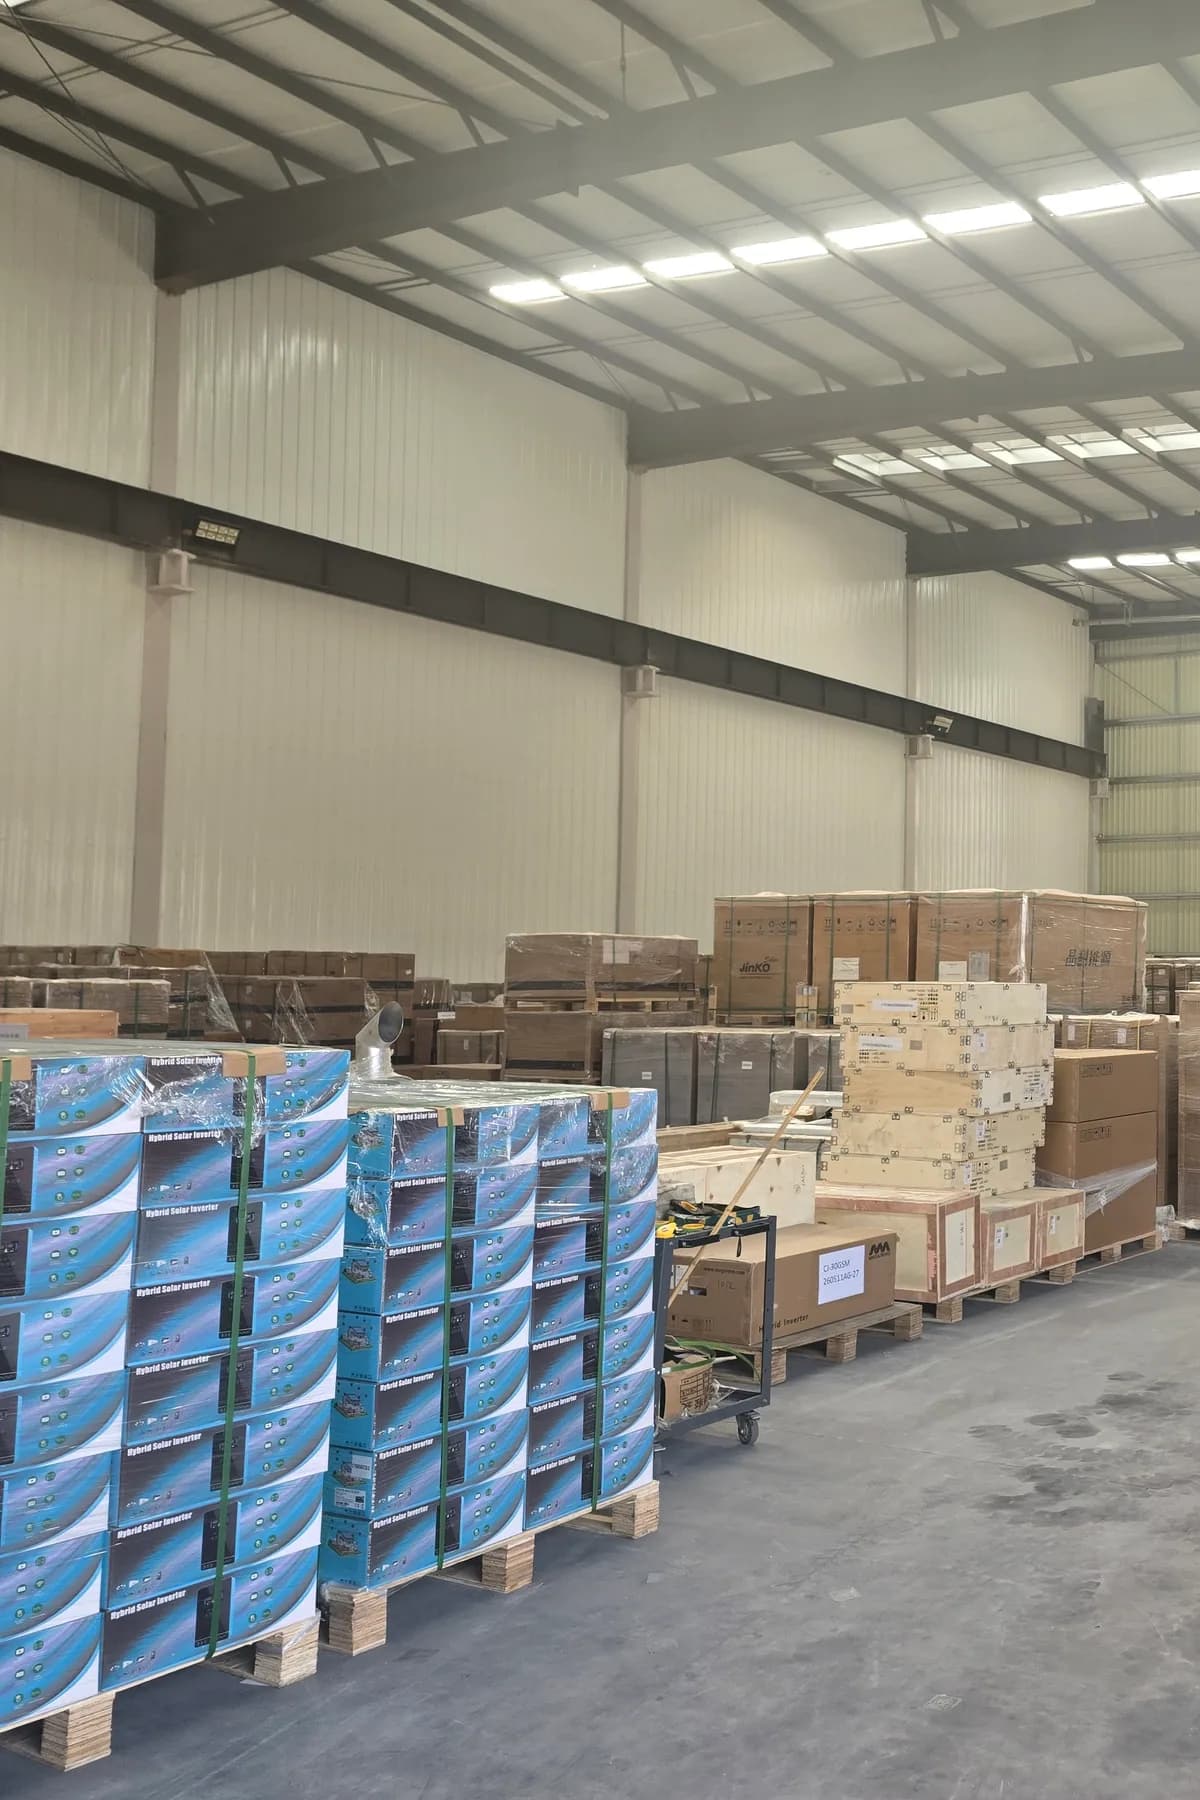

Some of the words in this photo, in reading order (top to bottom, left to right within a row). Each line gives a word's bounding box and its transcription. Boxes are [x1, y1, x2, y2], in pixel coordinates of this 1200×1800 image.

[151, 1058, 175, 1066] Hybrid
[176, 1057, 195, 1065] Solar
[149, 1133, 172, 1142] Hybrid
[173, 1132, 192, 1140] Solar
[146, 1208, 169, 1217] Hybrid
[171, 1207, 189, 1215] Solar
[190, 1204, 219, 1213] Inverter
[136, 1286, 161, 1297] Hybrid
[162, 1284, 181, 1293] Solar
[182, 1280, 211, 1290] Inverter
[784, 1314, 809, 1326] Inverter
[136, 1364, 160, 1375] Hybrid
[161, 1361, 180, 1370] Solar
[181, 1356, 209, 1367] Inverter
[127, 1444, 152, 1456] Hybrid
[152, 1440, 172, 1450] Solar
[173, 1433, 202, 1445] Inverter
[117, 1526, 142, 1539] Hybrid
[143, 1521, 163, 1531] Solar
[163, 1512, 193, 1525] Inverter
[110, 1606, 136, 1620] Hybrid
[136, 1600, 157, 1611] Solar
[157, 1590, 186, 1605] Inverter
